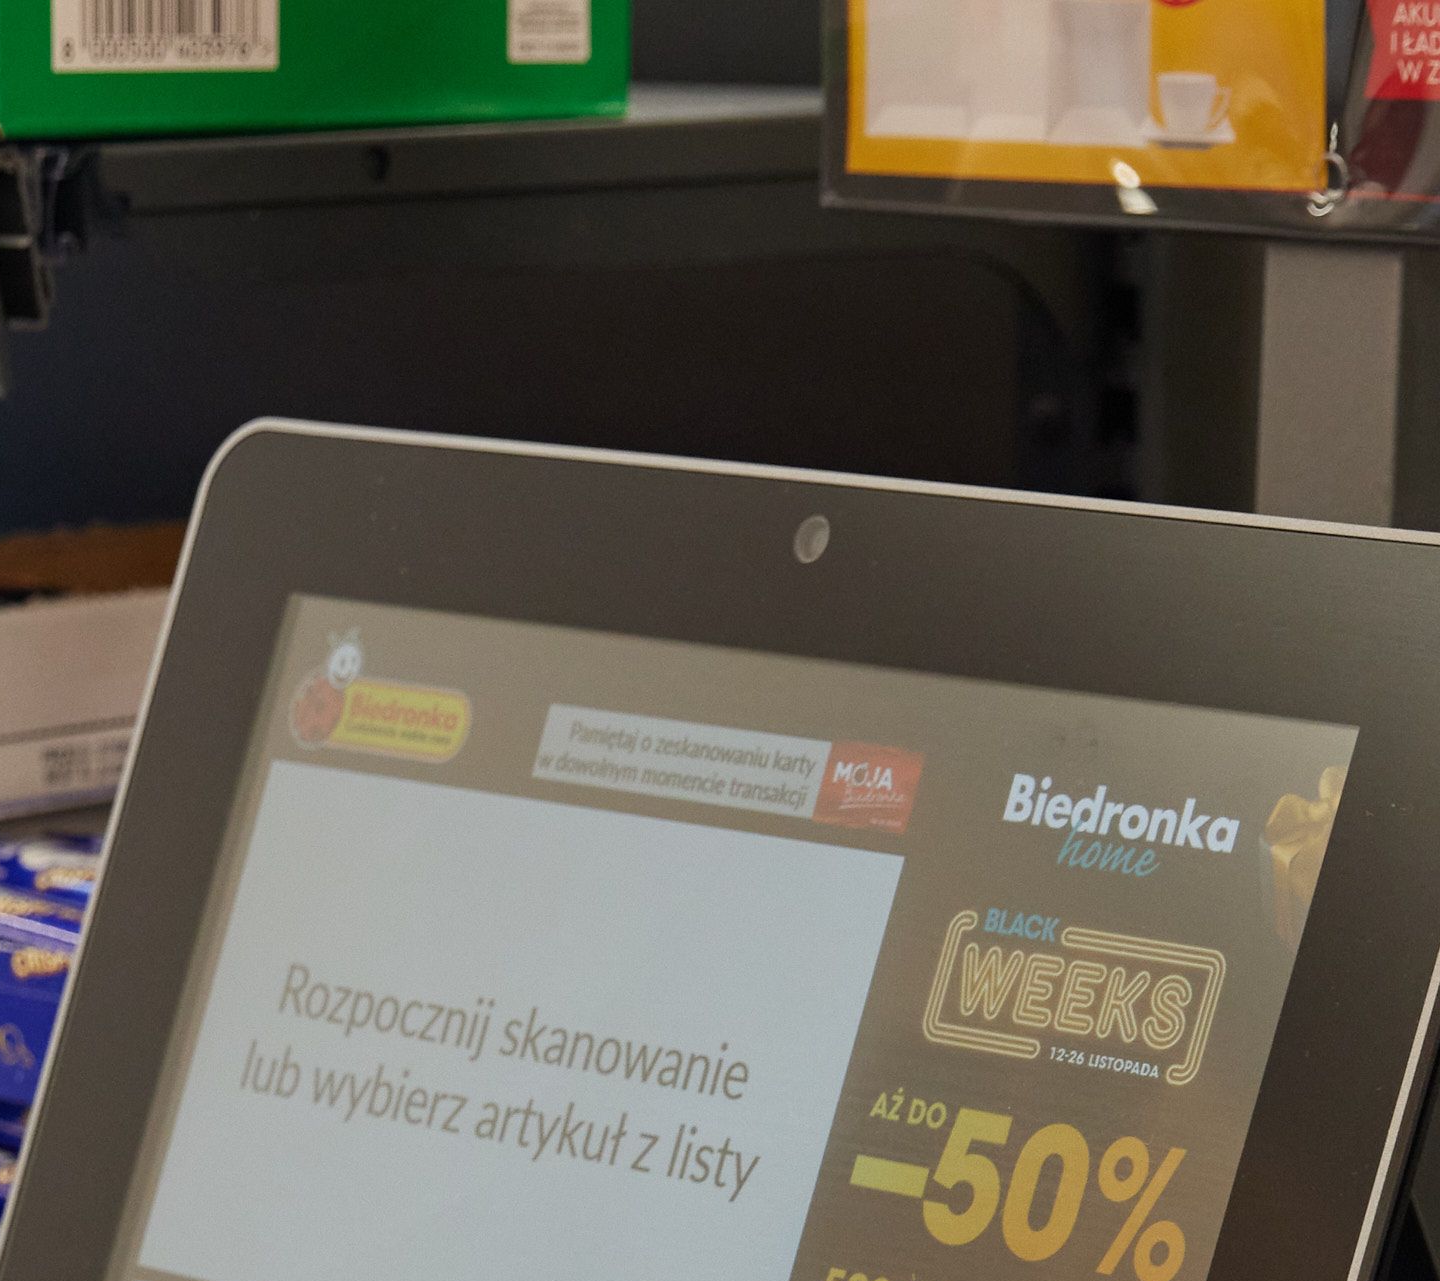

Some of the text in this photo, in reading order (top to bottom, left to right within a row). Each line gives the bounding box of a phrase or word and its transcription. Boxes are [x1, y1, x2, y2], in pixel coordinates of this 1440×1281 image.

[1396, 59, 1421, 83] W
[569, 720, 818, 780] Pamiętaj o zeskanowaniu karty
[831, 760, 894, 791] MOJA
[554, 753, 639, 785] dowolnym
[640, 767, 726, 795] momencie
[728, 777, 809, 809] transakcji
[1002, 773, 1241, 854] Biedronka
[1057, 821, 1161, 878] home
[982, 906, 1062, 943] BLACK
[958, 942, 1194, 1051] WEEKS
[278, 962, 750, 1100] Rozpocznij skanowanie
[1048, 1045, 1161, 1080] 12-26 LISTOPADA
[239, 1039, 761, 1203] lub wybierz artykuł z listy
[869, 1086, 948, 1130] AŻ DO
